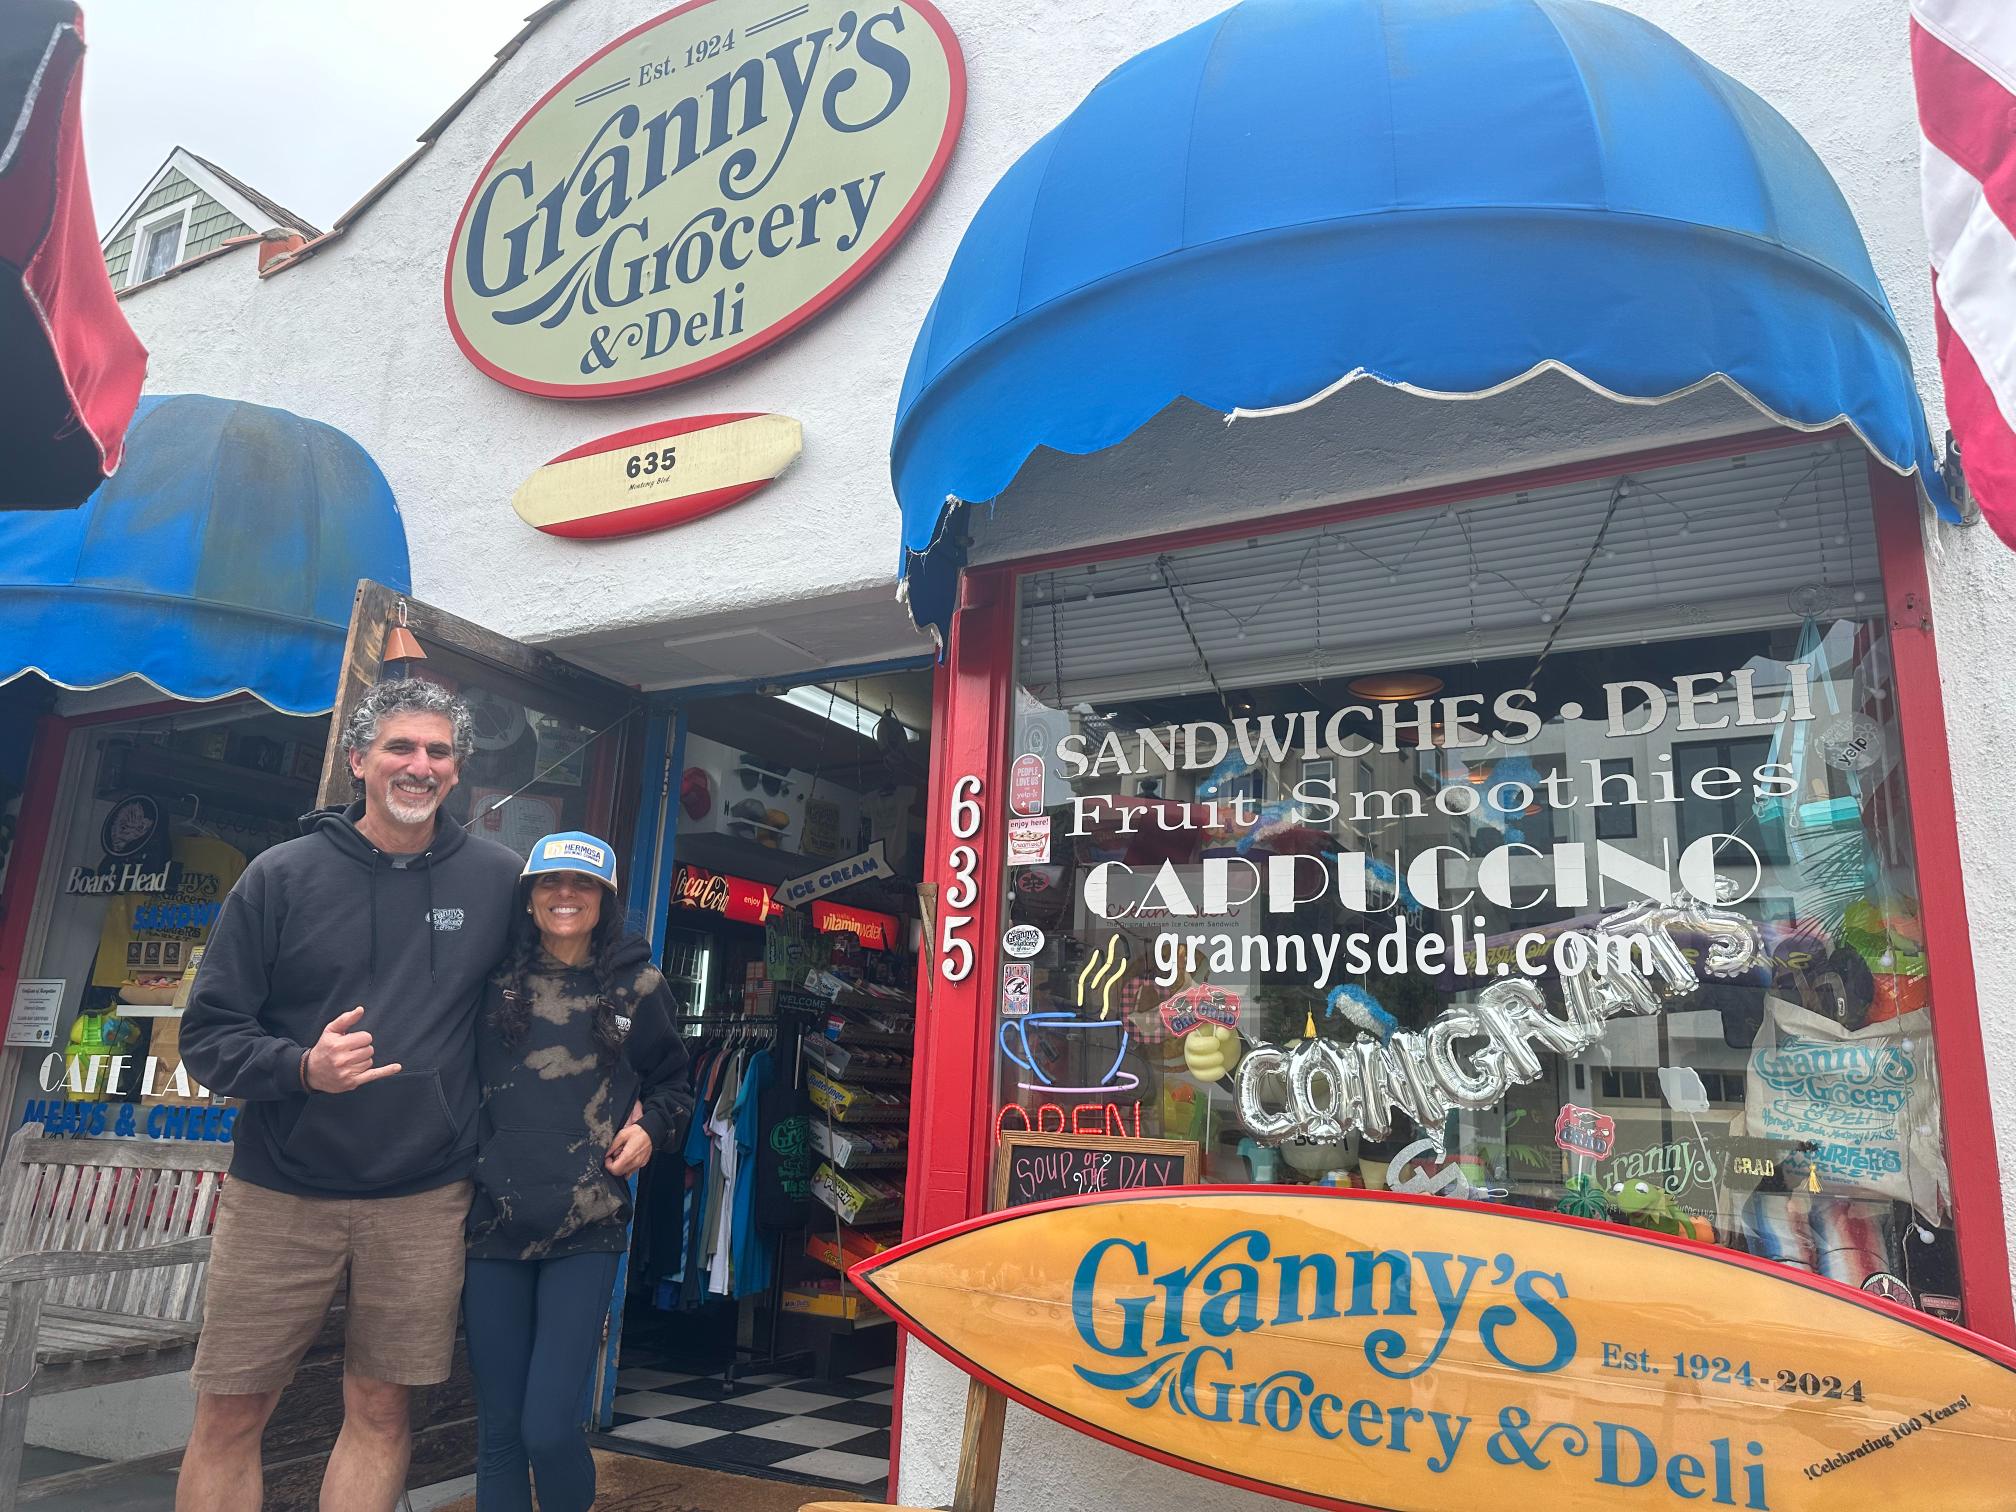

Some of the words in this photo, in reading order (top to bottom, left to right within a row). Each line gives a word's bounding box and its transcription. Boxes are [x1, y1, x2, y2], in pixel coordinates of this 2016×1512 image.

[639, 61, 676, 88] Est.
[684, 29, 736, 68] 1924
[465, 5, 912, 299] Granny's
[592, 171, 886, 309] Grocery
[579, 320, 643, 375] &
[643, 282, 745, 361] Deli
[626, 447, 676, 479] 635
[1054, 688, 1544, 780] SANDWICHES
[1601, 664, 1818, 740] DELI
[1017, 766, 1039, 777] PEOPLE
[1838, 737, 1867, 766] yelp
[1016, 777, 1030, 787] LOVE
[1031, 777, 1039, 786] US
[1064, 786, 1259, 838] Fruit
[1290, 752, 1799, 823] Smoothies
[1010, 820, 1029, 829] enjoy
[1030, 818, 1049, 827] here!
[564, 843, 601, 860] HERMOSA
[65, 863, 117, 894] Boar's
[118, 860, 172, 893] Head
[786, 880, 815, 900] ICE
[819, 856, 879, 888] CREAM
[941, 774, 982, 982] 635
[1083, 832, 1762, 920] CAPPUCCINO
[744, 896, 761, 907] enjoy
[822, 912, 883, 939] vitaminwater
[1006, 928, 1039, 944] Granny's
[1154, 914, 1654, 989] grannysdeli.com
[780, 993, 827, 1009] WELCOME
[38, 1051, 133, 1096] CAFE
[1804, 1075, 1914, 1114] Grocery
[21, 1097, 109, 1136] MEATS
[114, 1103, 136, 1137] &
[147, 1103, 241, 1144] CHEES
[995, 1102, 1142, 1148] OPEN
[1561, 1127, 1607, 1151] GRAD
[1016, 1151, 1073, 1198] SOUP
[1080, 1167, 1110, 1188] THE
[1083, 1151, 1102, 1167] OF
[1119, 1155, 1172, 1190] DAY
[1733, 1156, 1775, 1178] GRAD
[1071, 1229, 1578, 1380] Granny's
[1601, 1341, 1660, 1375] Est.
[1673, 1351, 1866, 1403] 1924-2024
[1179, 1345, 1472, 1474] Grocery
[1486, 1406, 1589, 1471] &
[1593, 1420, 1770, 1511] Deli
[1889, 1417, 1923, 1441] 100
[1920, 1394, 1972, 1426] Years!
